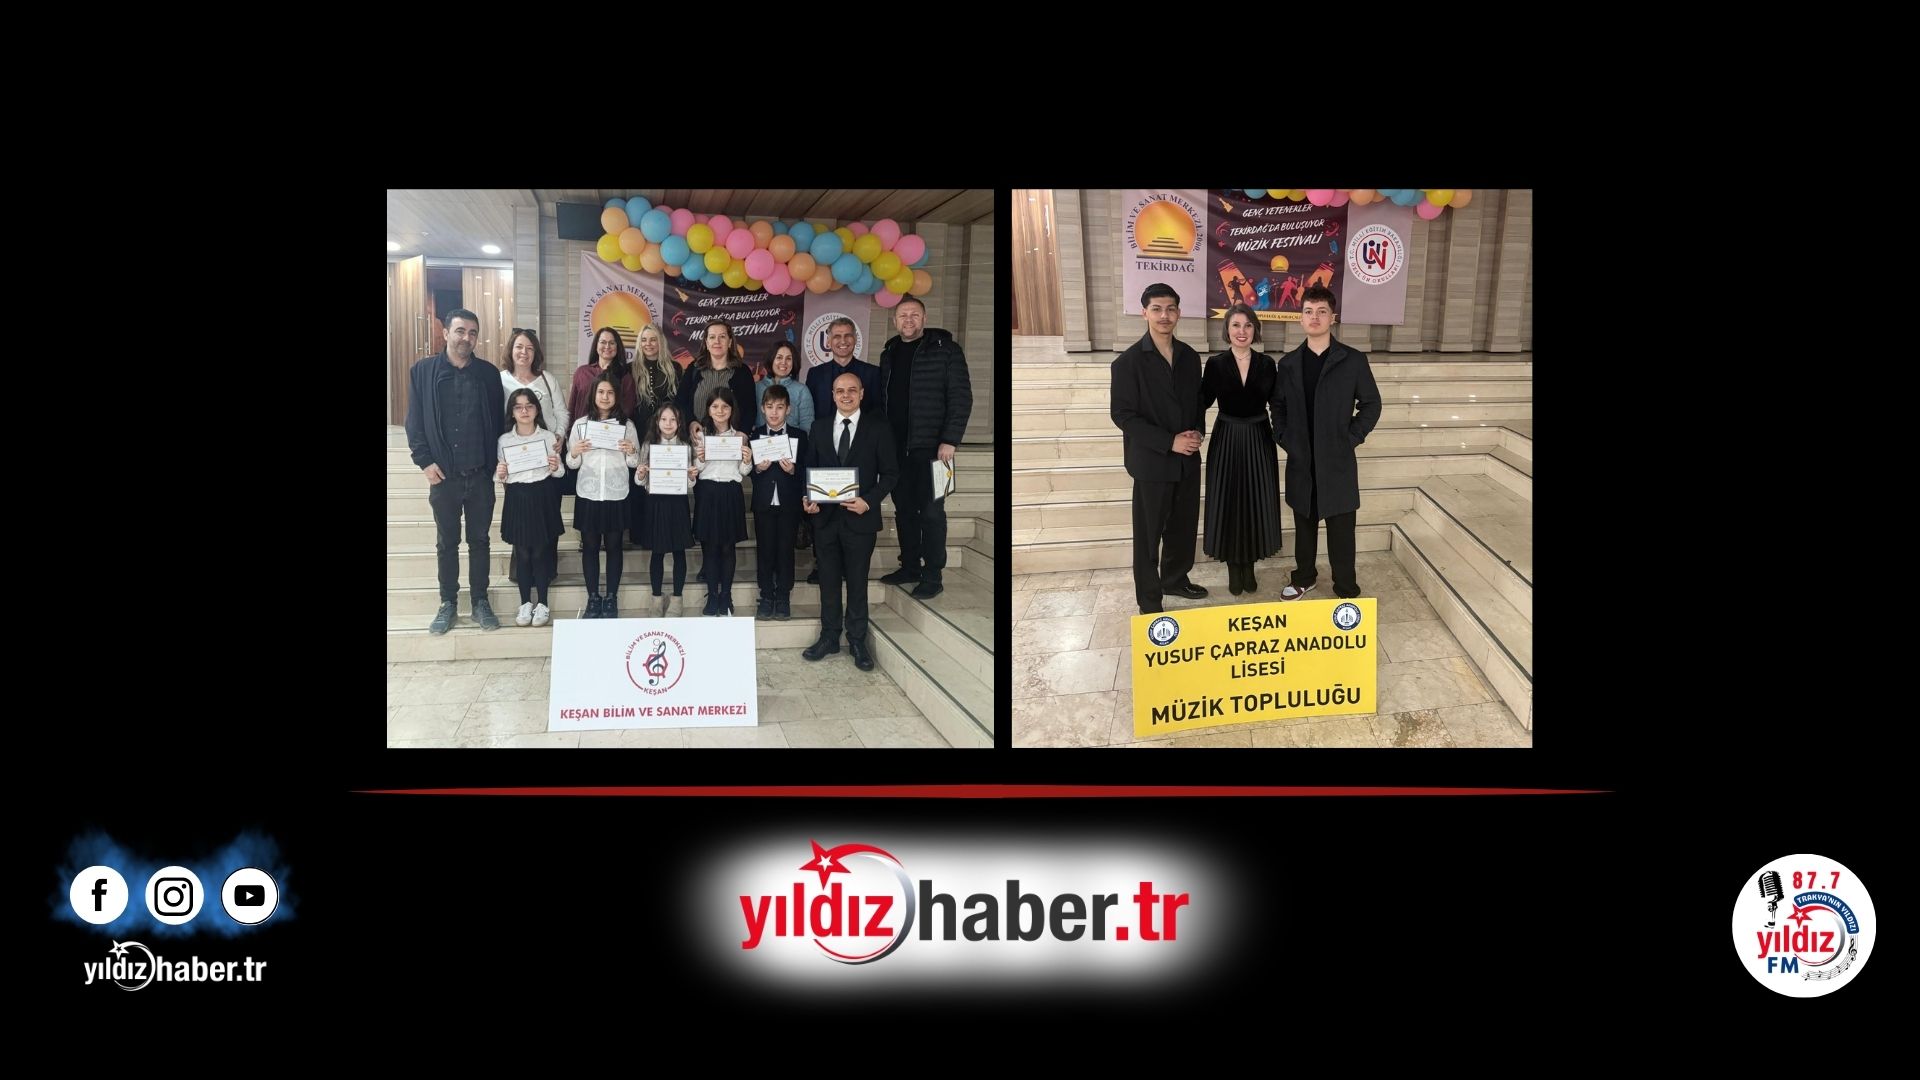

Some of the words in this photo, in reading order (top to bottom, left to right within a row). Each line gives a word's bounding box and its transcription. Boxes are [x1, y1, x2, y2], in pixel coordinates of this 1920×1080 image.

[1139, 194, 1167, 209] SANAT
[1130, 207, 1140, 218] VE
[1242, 207, 1265, 218] GENÇ
[1265, 203, 1313, 216] YETENEKLER
[1281, 219, 1325, 231] BULUŞUYOR
[1126, 221, 1137, 249] BİLİM
[1234, 238, 1270, 252] MÜZİK
[1270, 231, 1324, 249] FESTİVALİ
[1136, 261, 1195, 273] TEKİRDAĞ
[596, 284, 624, 298] SANAT
[587, 297, 597, 308] VE
[698, 297, 720, 308] GENÇ
[720, 293, 769, 305] YETENEKLER
[736, 308, 781, 320] BULUŞUYOR
[583, 310, 593, 338] BİLİM
[732, 320, 780, 336] ESTİVALİ
[1228, 614, 1287, 632] KEŞAN
[625, 641, 637, 660] BİLİM
[635, 634, 644, 642] VE
[664, 633, 686, 656] MERKEZİ
[1145, 646, 1205, 667] YUSUF
[1210, 639, 1280, 661] ÇAPRAZ
[1284, 634, 1367, 653] ANADOLU
[1231, 657, 1285, 679] LİSESİ
[643, 687, 668, 696] KEŞAN
[560, 708, 599, 721] KEŞAN
[603, 704, 635, 718] BİLİM
[639, 706, 653, 717] VE
[656, 705, 695, 717] SANAT
[697, 702, 747, 716] MERKEZİ
[1151, 695, 1224, 725] MÜZİK
[1230, 683, 1361, 714] TOPLULUĞU
